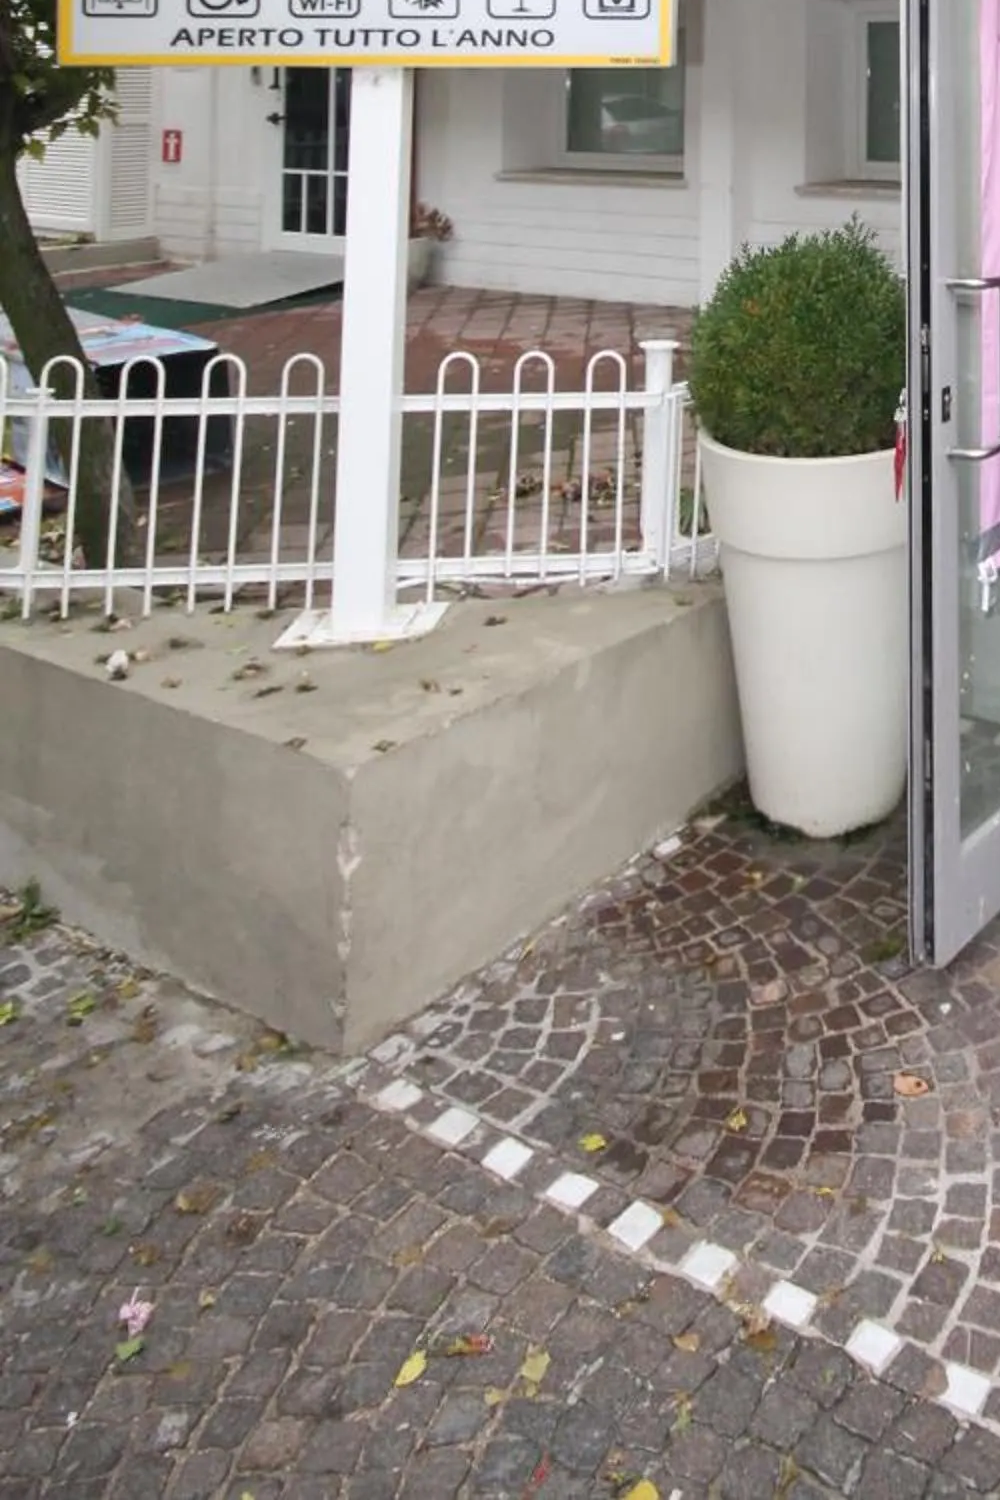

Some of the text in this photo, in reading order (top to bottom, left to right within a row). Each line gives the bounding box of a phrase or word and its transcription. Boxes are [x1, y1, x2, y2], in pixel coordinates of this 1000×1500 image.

[169, 27, 555, 47] APERTO TUTTO L'ANNO
